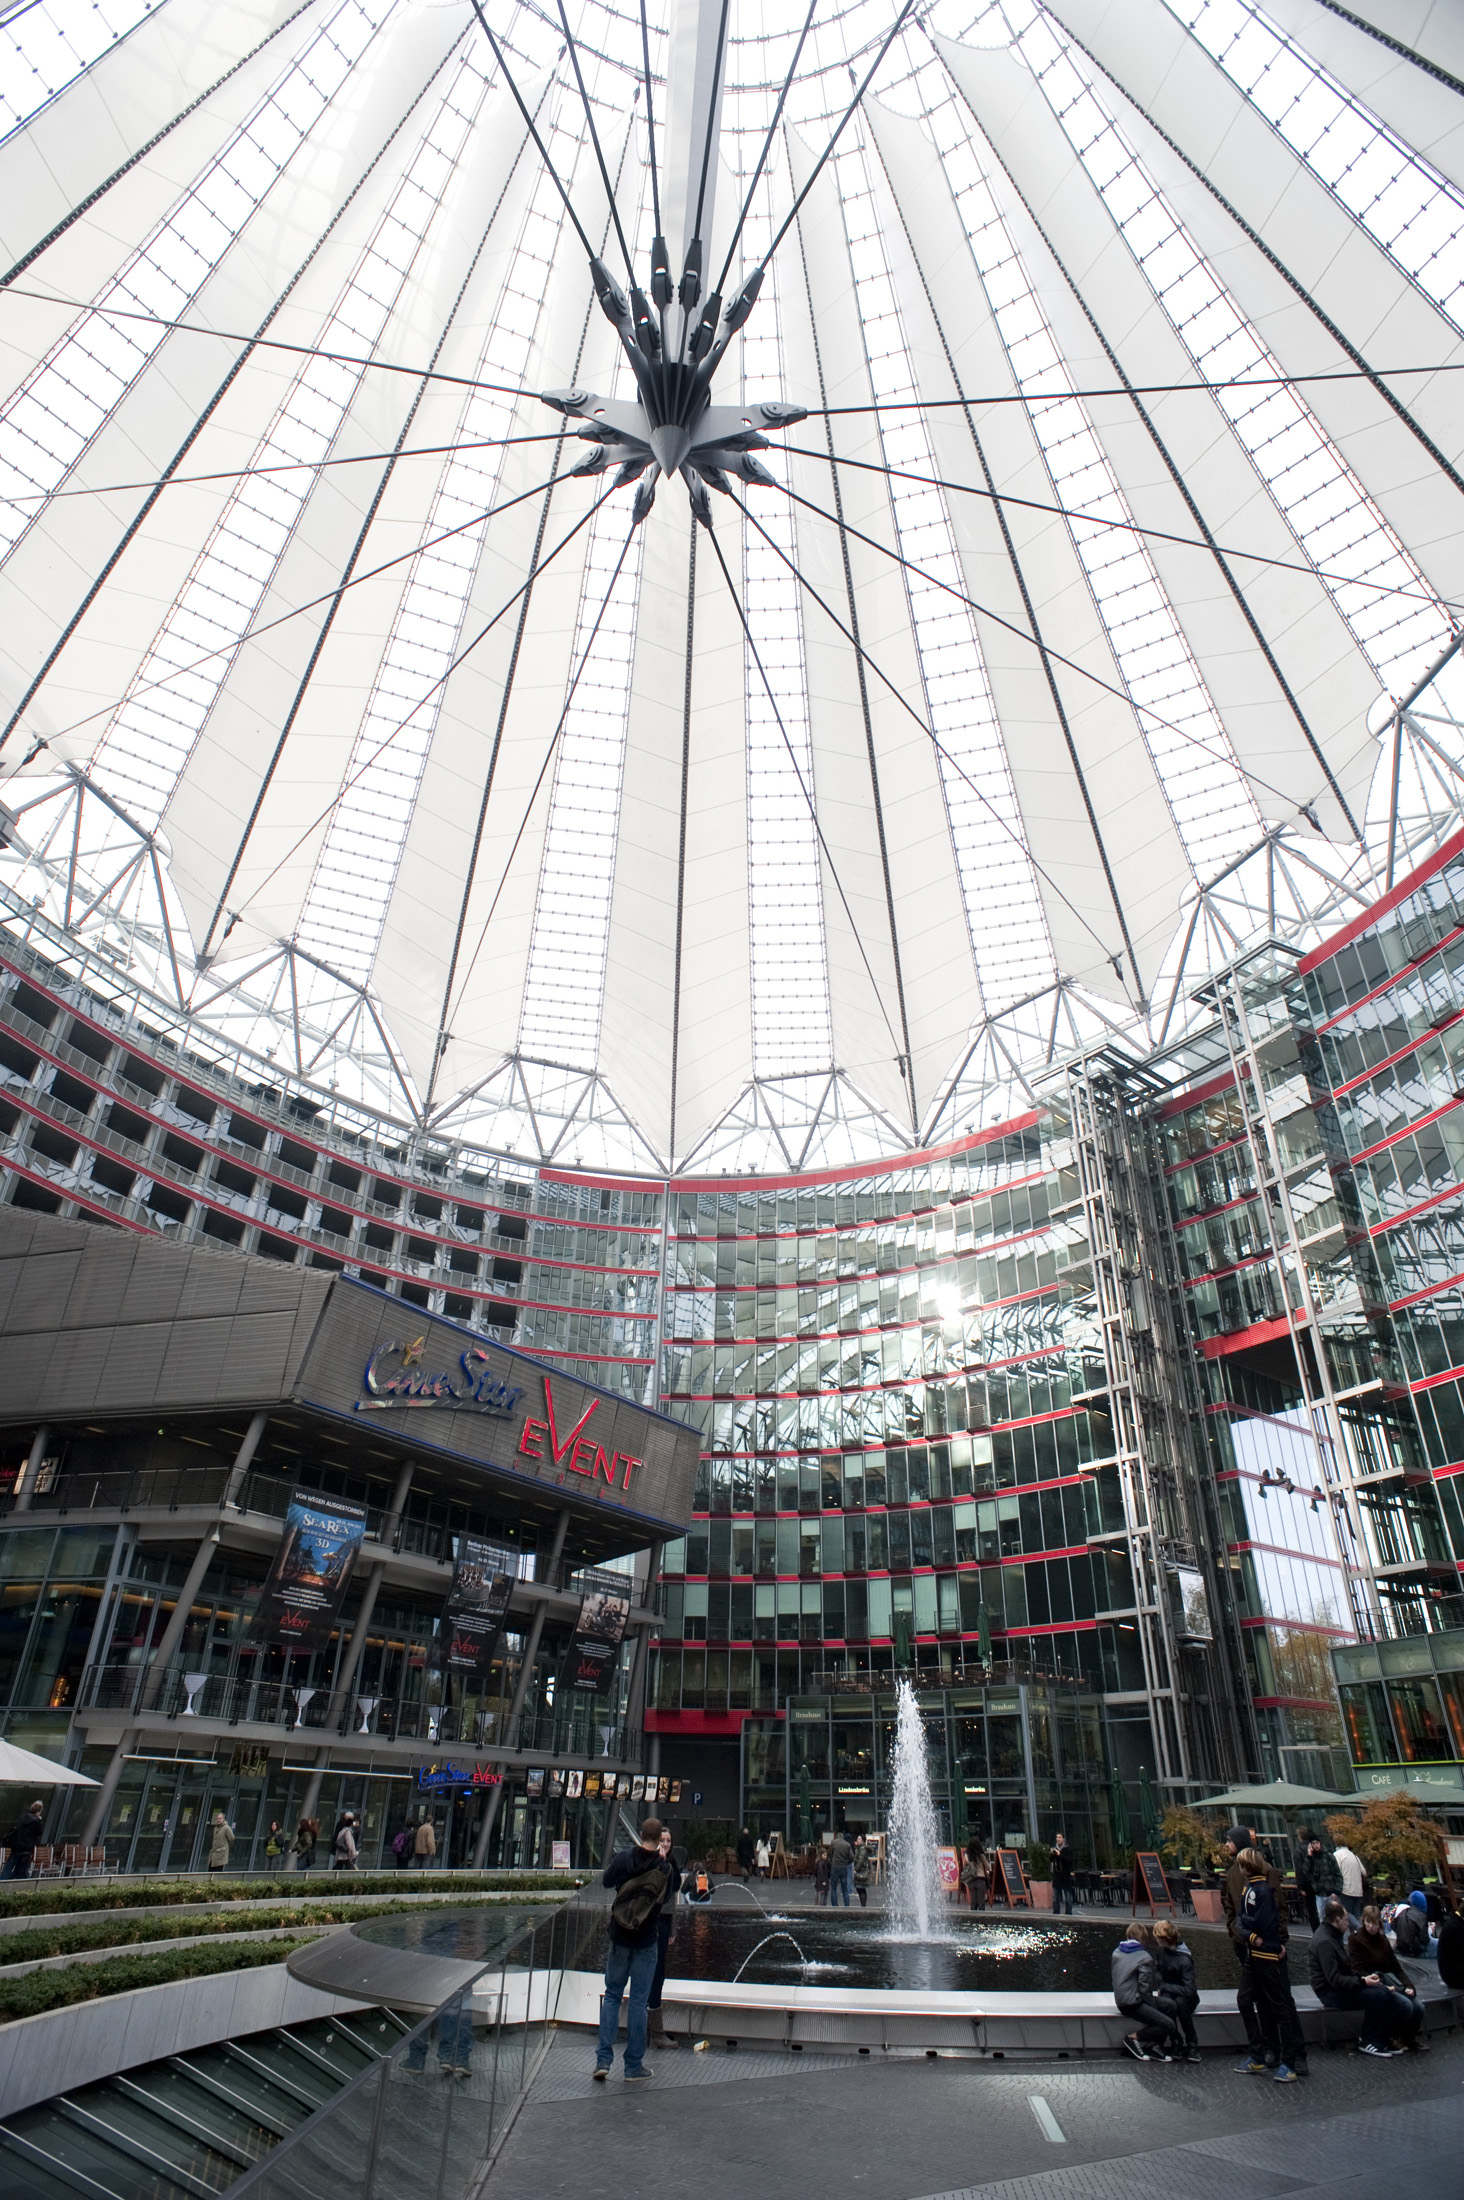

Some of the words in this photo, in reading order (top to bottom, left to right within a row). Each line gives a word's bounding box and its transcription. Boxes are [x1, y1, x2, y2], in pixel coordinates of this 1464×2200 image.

[518, 1376, 643, 1490] EVENT
[295, 1491, 307, 1500] VON
[307, 1495, 325, 1505] WEGEN
[315, 1537, 330, 1549] 3D
[279, 1608, 311, 1628] EVENT
[450, 1632, 481, 1654] EVENT
[577, 1658, 602, 1677] EVENT
[991, 1703, 1016, 1711] Brauhaus
[795, 1711, 821, 1719] Brauhaus
[473, 1763, 503, 1784] EVENT
[1371, 1773, 1392, 1785] CAFÉ
[694, 1792, 701, 1804] P
